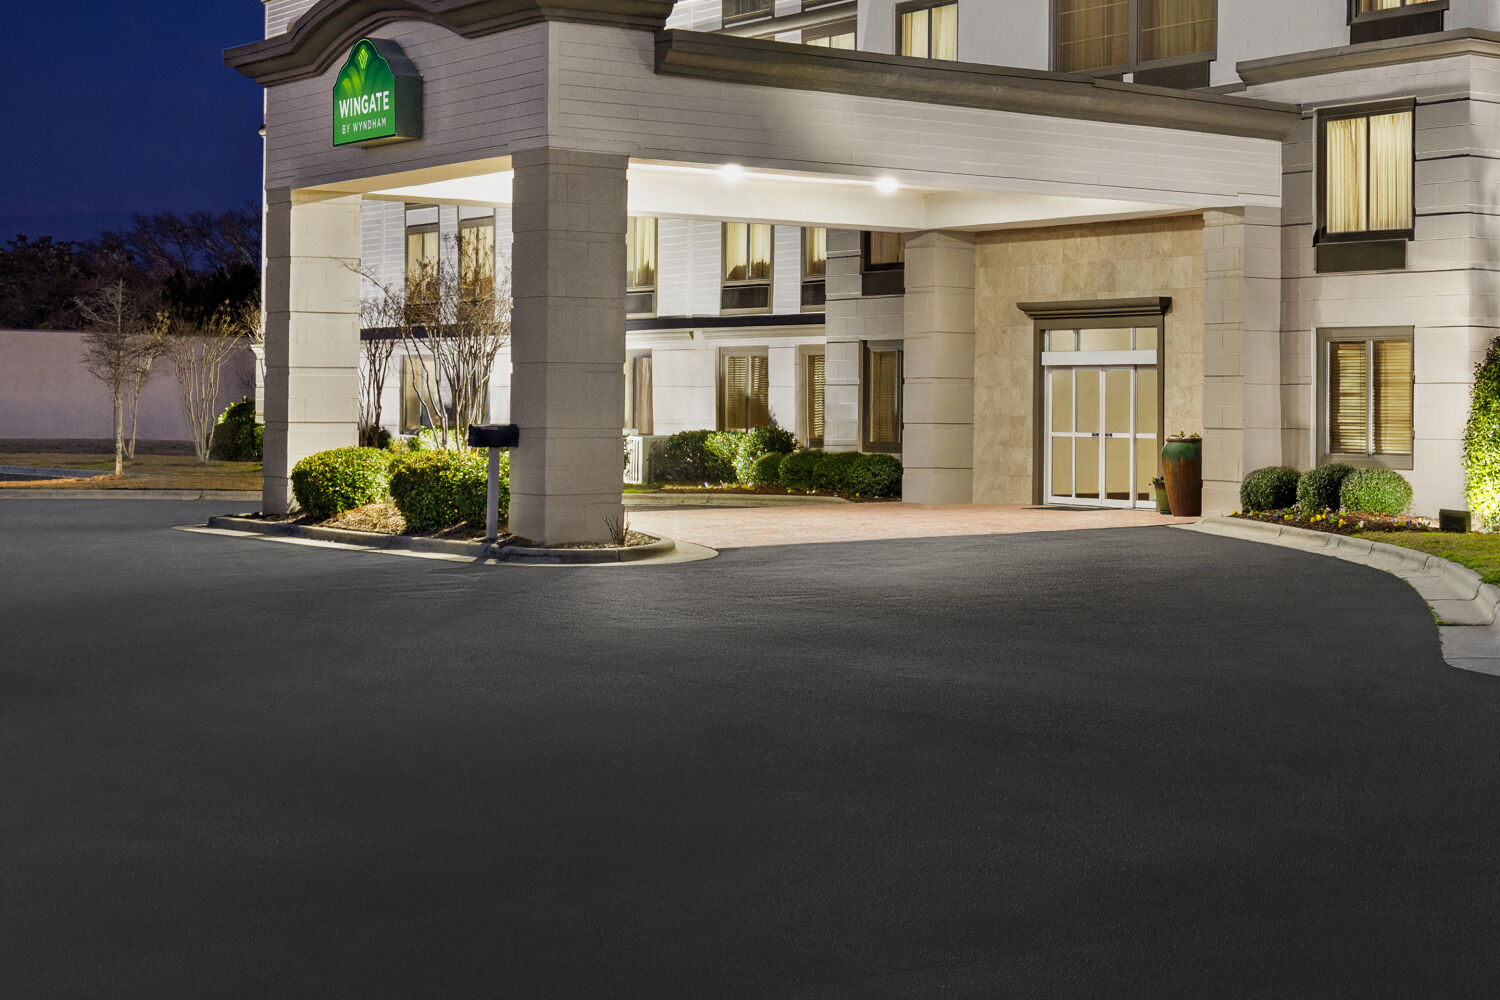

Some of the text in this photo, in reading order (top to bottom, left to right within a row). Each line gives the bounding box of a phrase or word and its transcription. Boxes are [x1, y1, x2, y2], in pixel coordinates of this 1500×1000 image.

[339, 90, 390, 119] WINGATE
[342, 117, 387, 135] BY WYNDHAM
